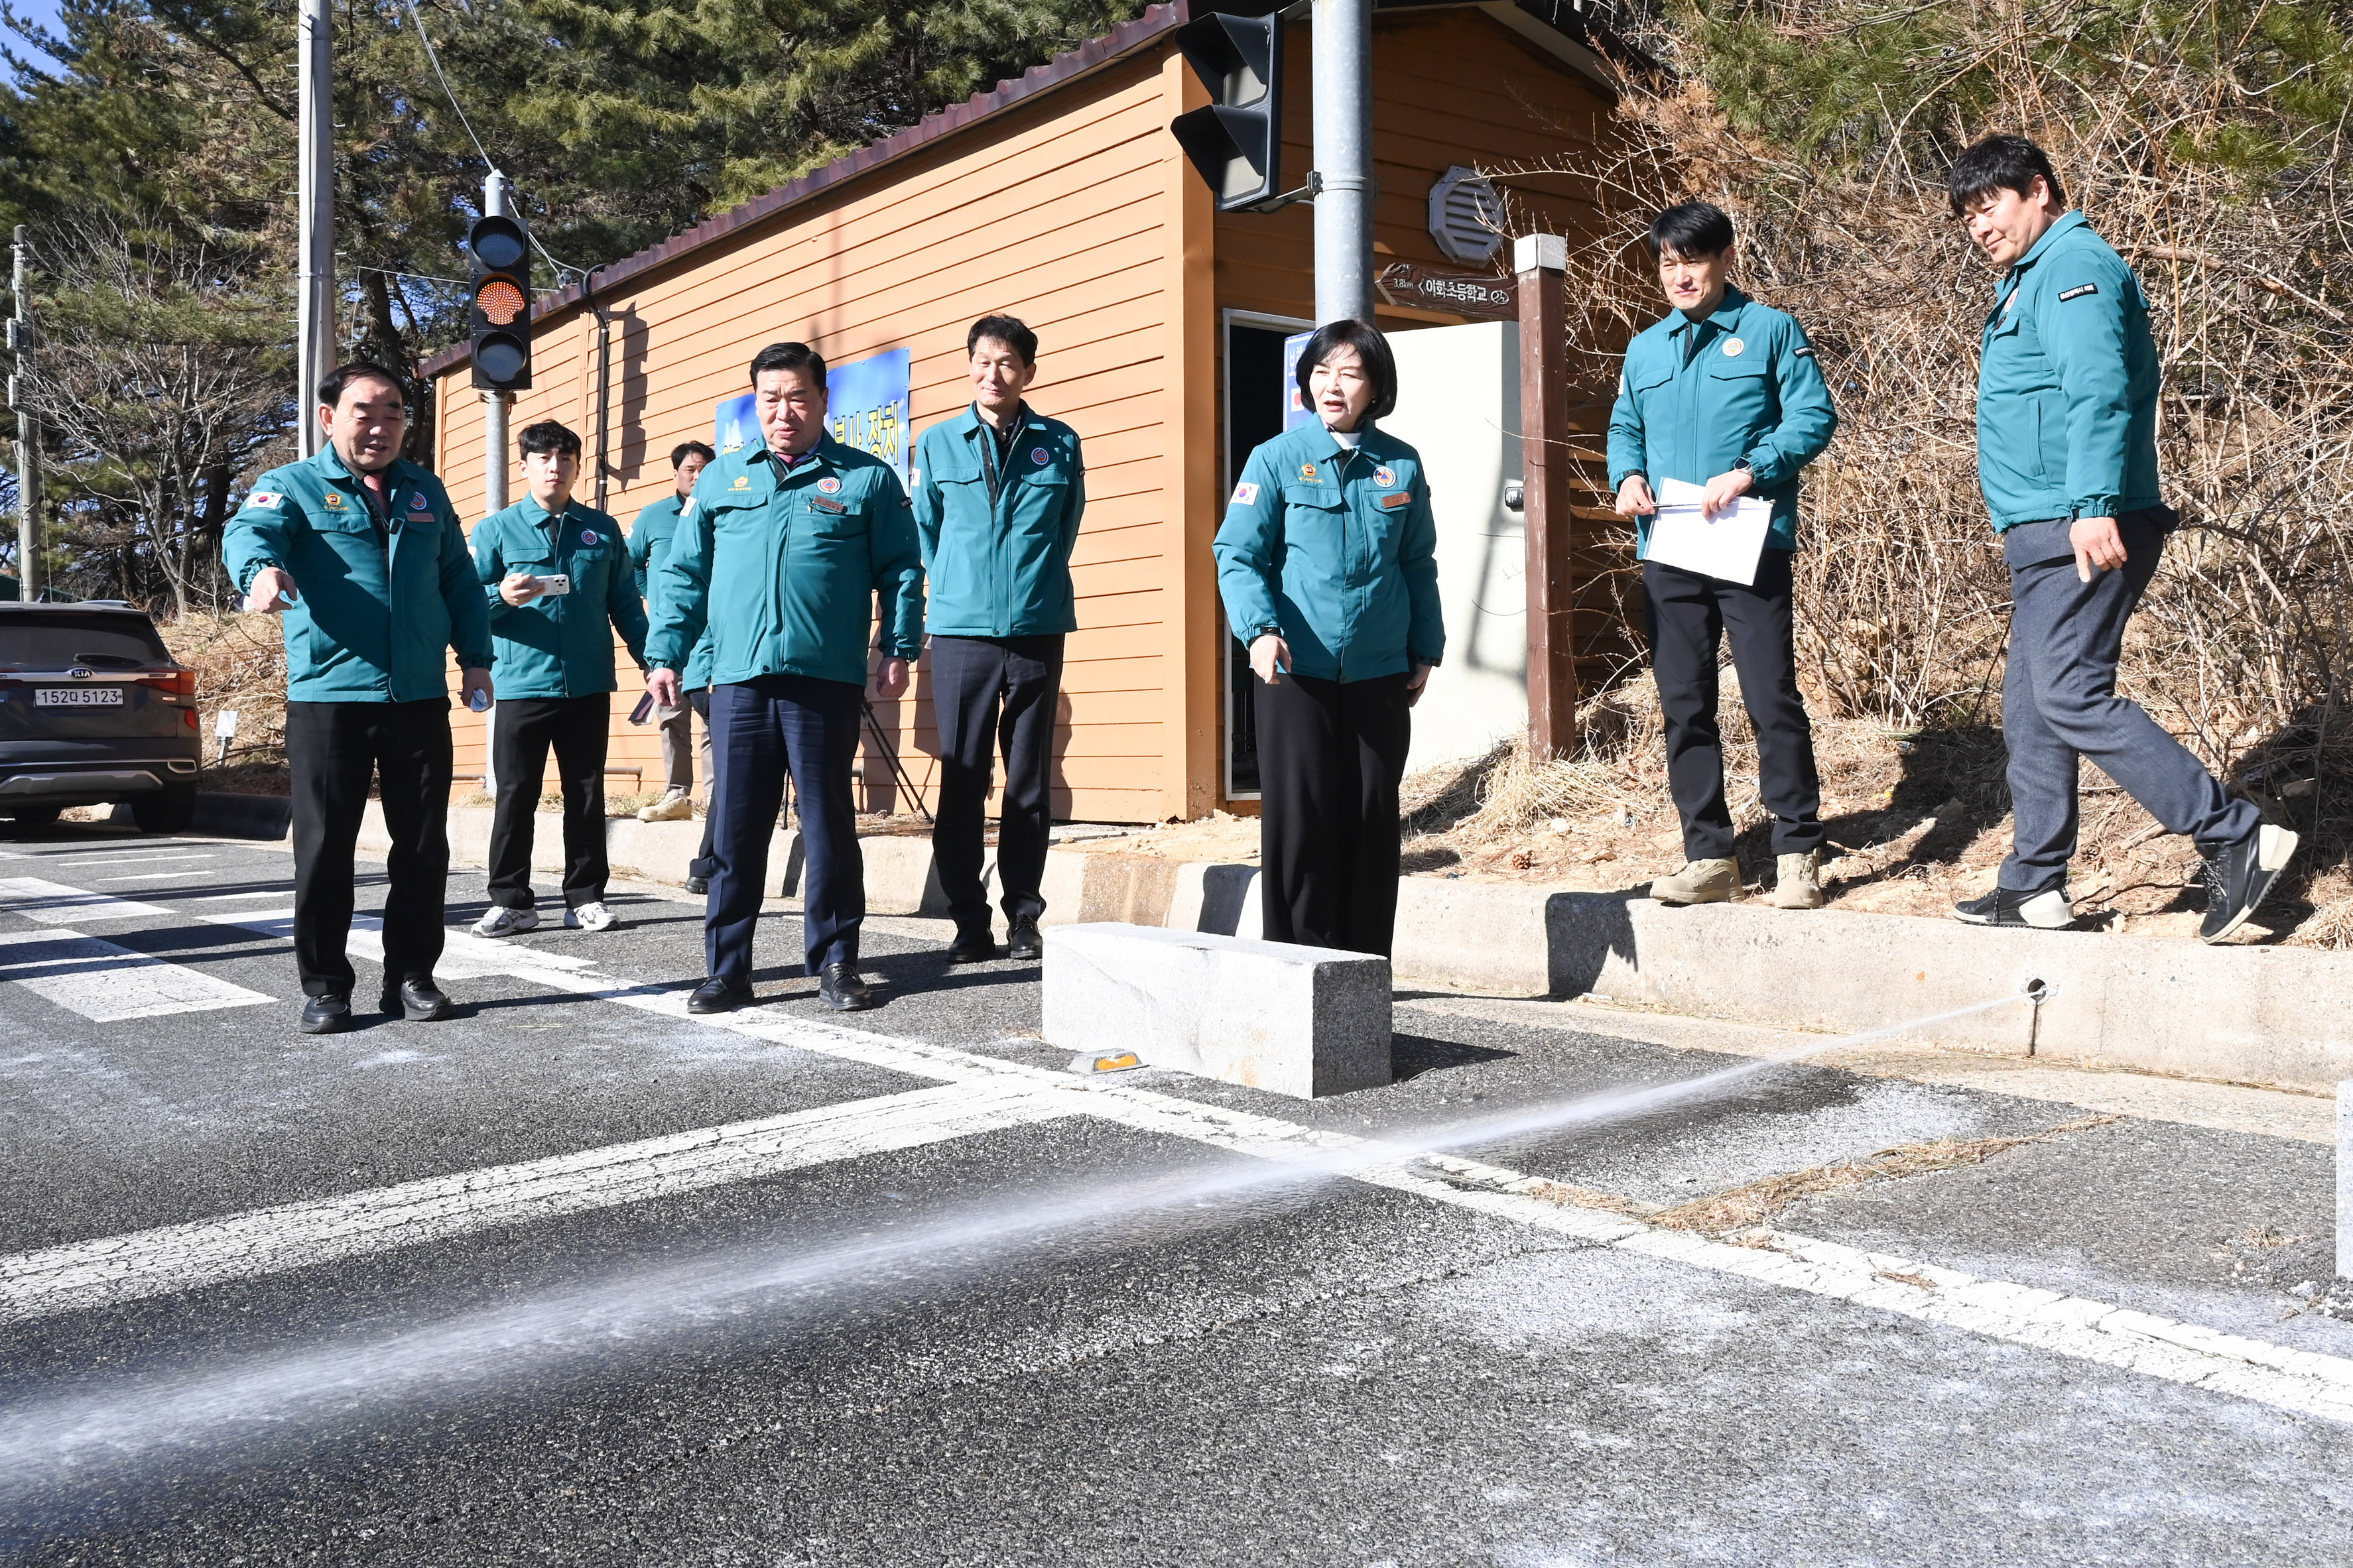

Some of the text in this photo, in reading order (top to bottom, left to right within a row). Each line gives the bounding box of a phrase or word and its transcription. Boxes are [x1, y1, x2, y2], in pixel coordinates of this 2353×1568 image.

[1426, 279, 1488, 302] 이화초등학교
[866, 400, 899, 466] 장치
[41, 690, 117, 703] 152다 5123
